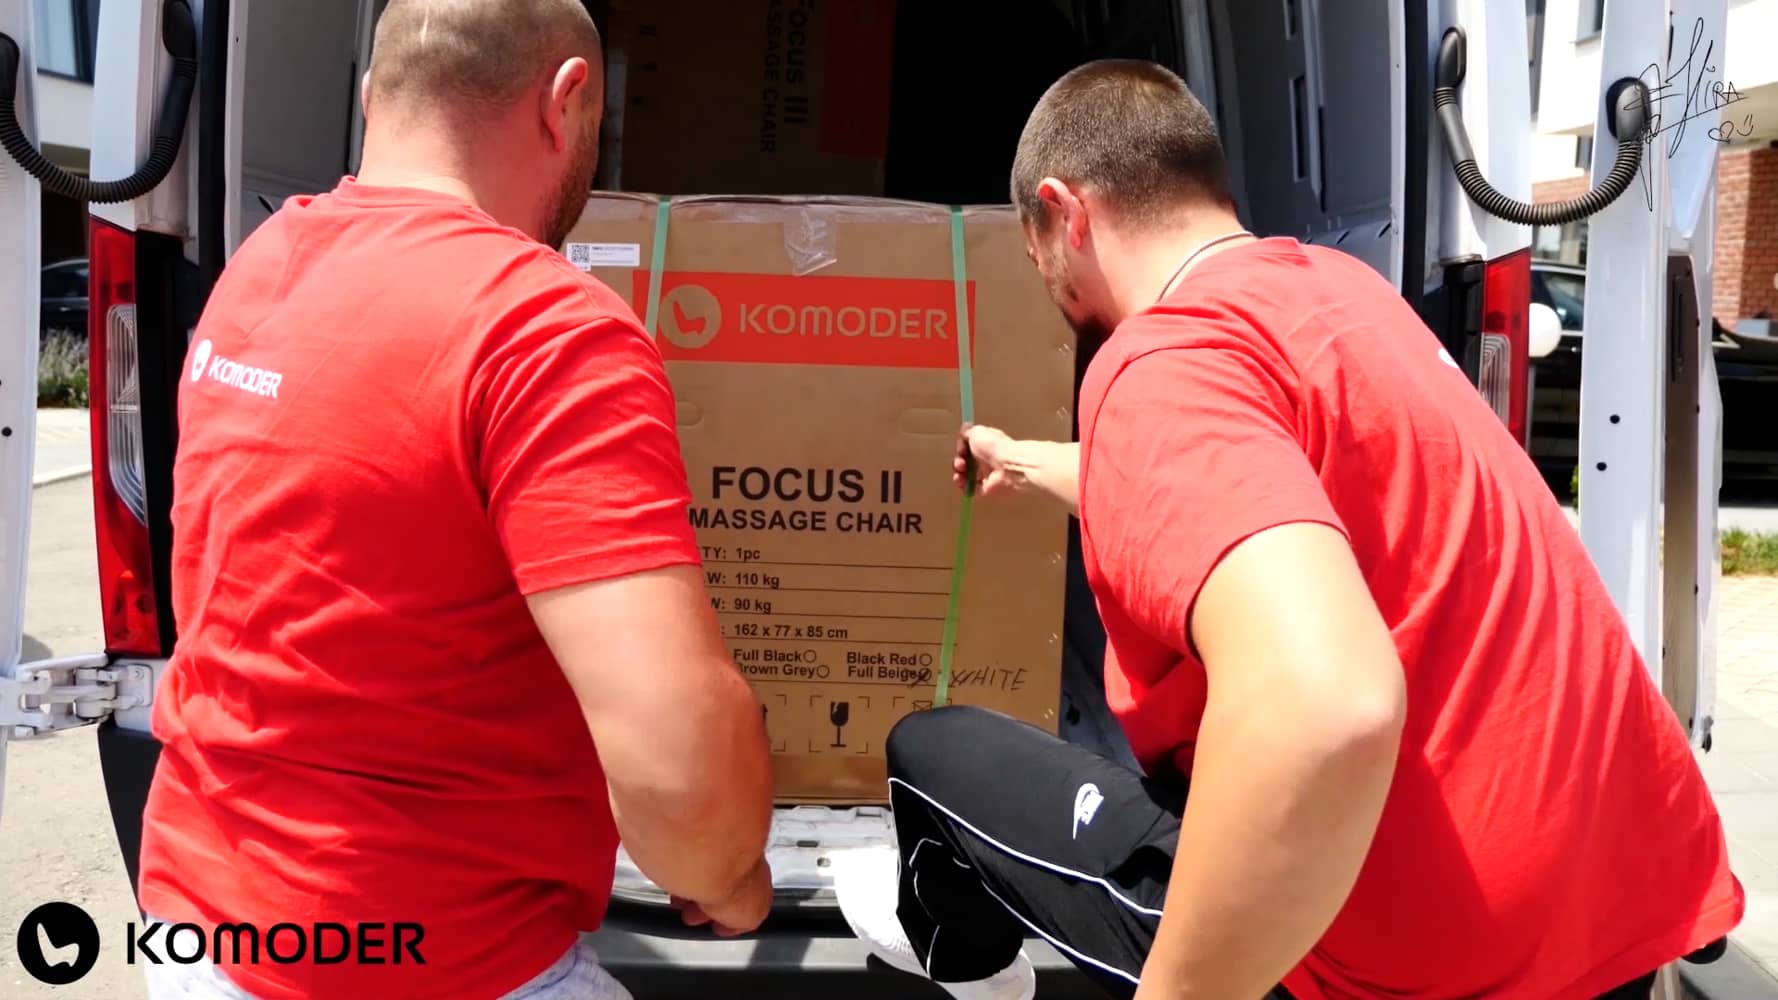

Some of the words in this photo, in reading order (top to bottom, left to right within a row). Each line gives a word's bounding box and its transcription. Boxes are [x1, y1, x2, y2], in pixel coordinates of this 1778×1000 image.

[764, 0, 783, 81] ASSAGE
[760, 88, 779, 152] CHAIR
[739, 303, 949, 340] KOMODER
[208, 355, 283, 399] KOMODER
[712, 466, 865, 503] FOCUS
[880, 470, 902, 503] II
[689, 508, 827, 532] MASSAGE
[836, 511, 923, 534] CHAIR
[696, 545, 727, 560] TY:
[735, 547, 761, 563] 1pc
[735, 573, 759, 586] 110
[763, 573, 780, 590] kg
[734, 598, 751, 611] 90
[755, 599, 772, 615] kg
[734, 623, 758, 636] 162
[762, 627, 770, 637] x
[774, 624, 791, 638] 77
[795, 628, 803, 638] x
[807, 625, 824, 638] 85
[827, 628, 848, 639] cm
[733, 648, 759, 661] Full
[763, 649, 802, 662] Black
[847, 652, 885, 665] Black
[889, 653, 917, 666] Red
[782, 663, 815, 679] Grey
[848, 666, 874, 679] Full
[878, 666, 923, 682] Beige
